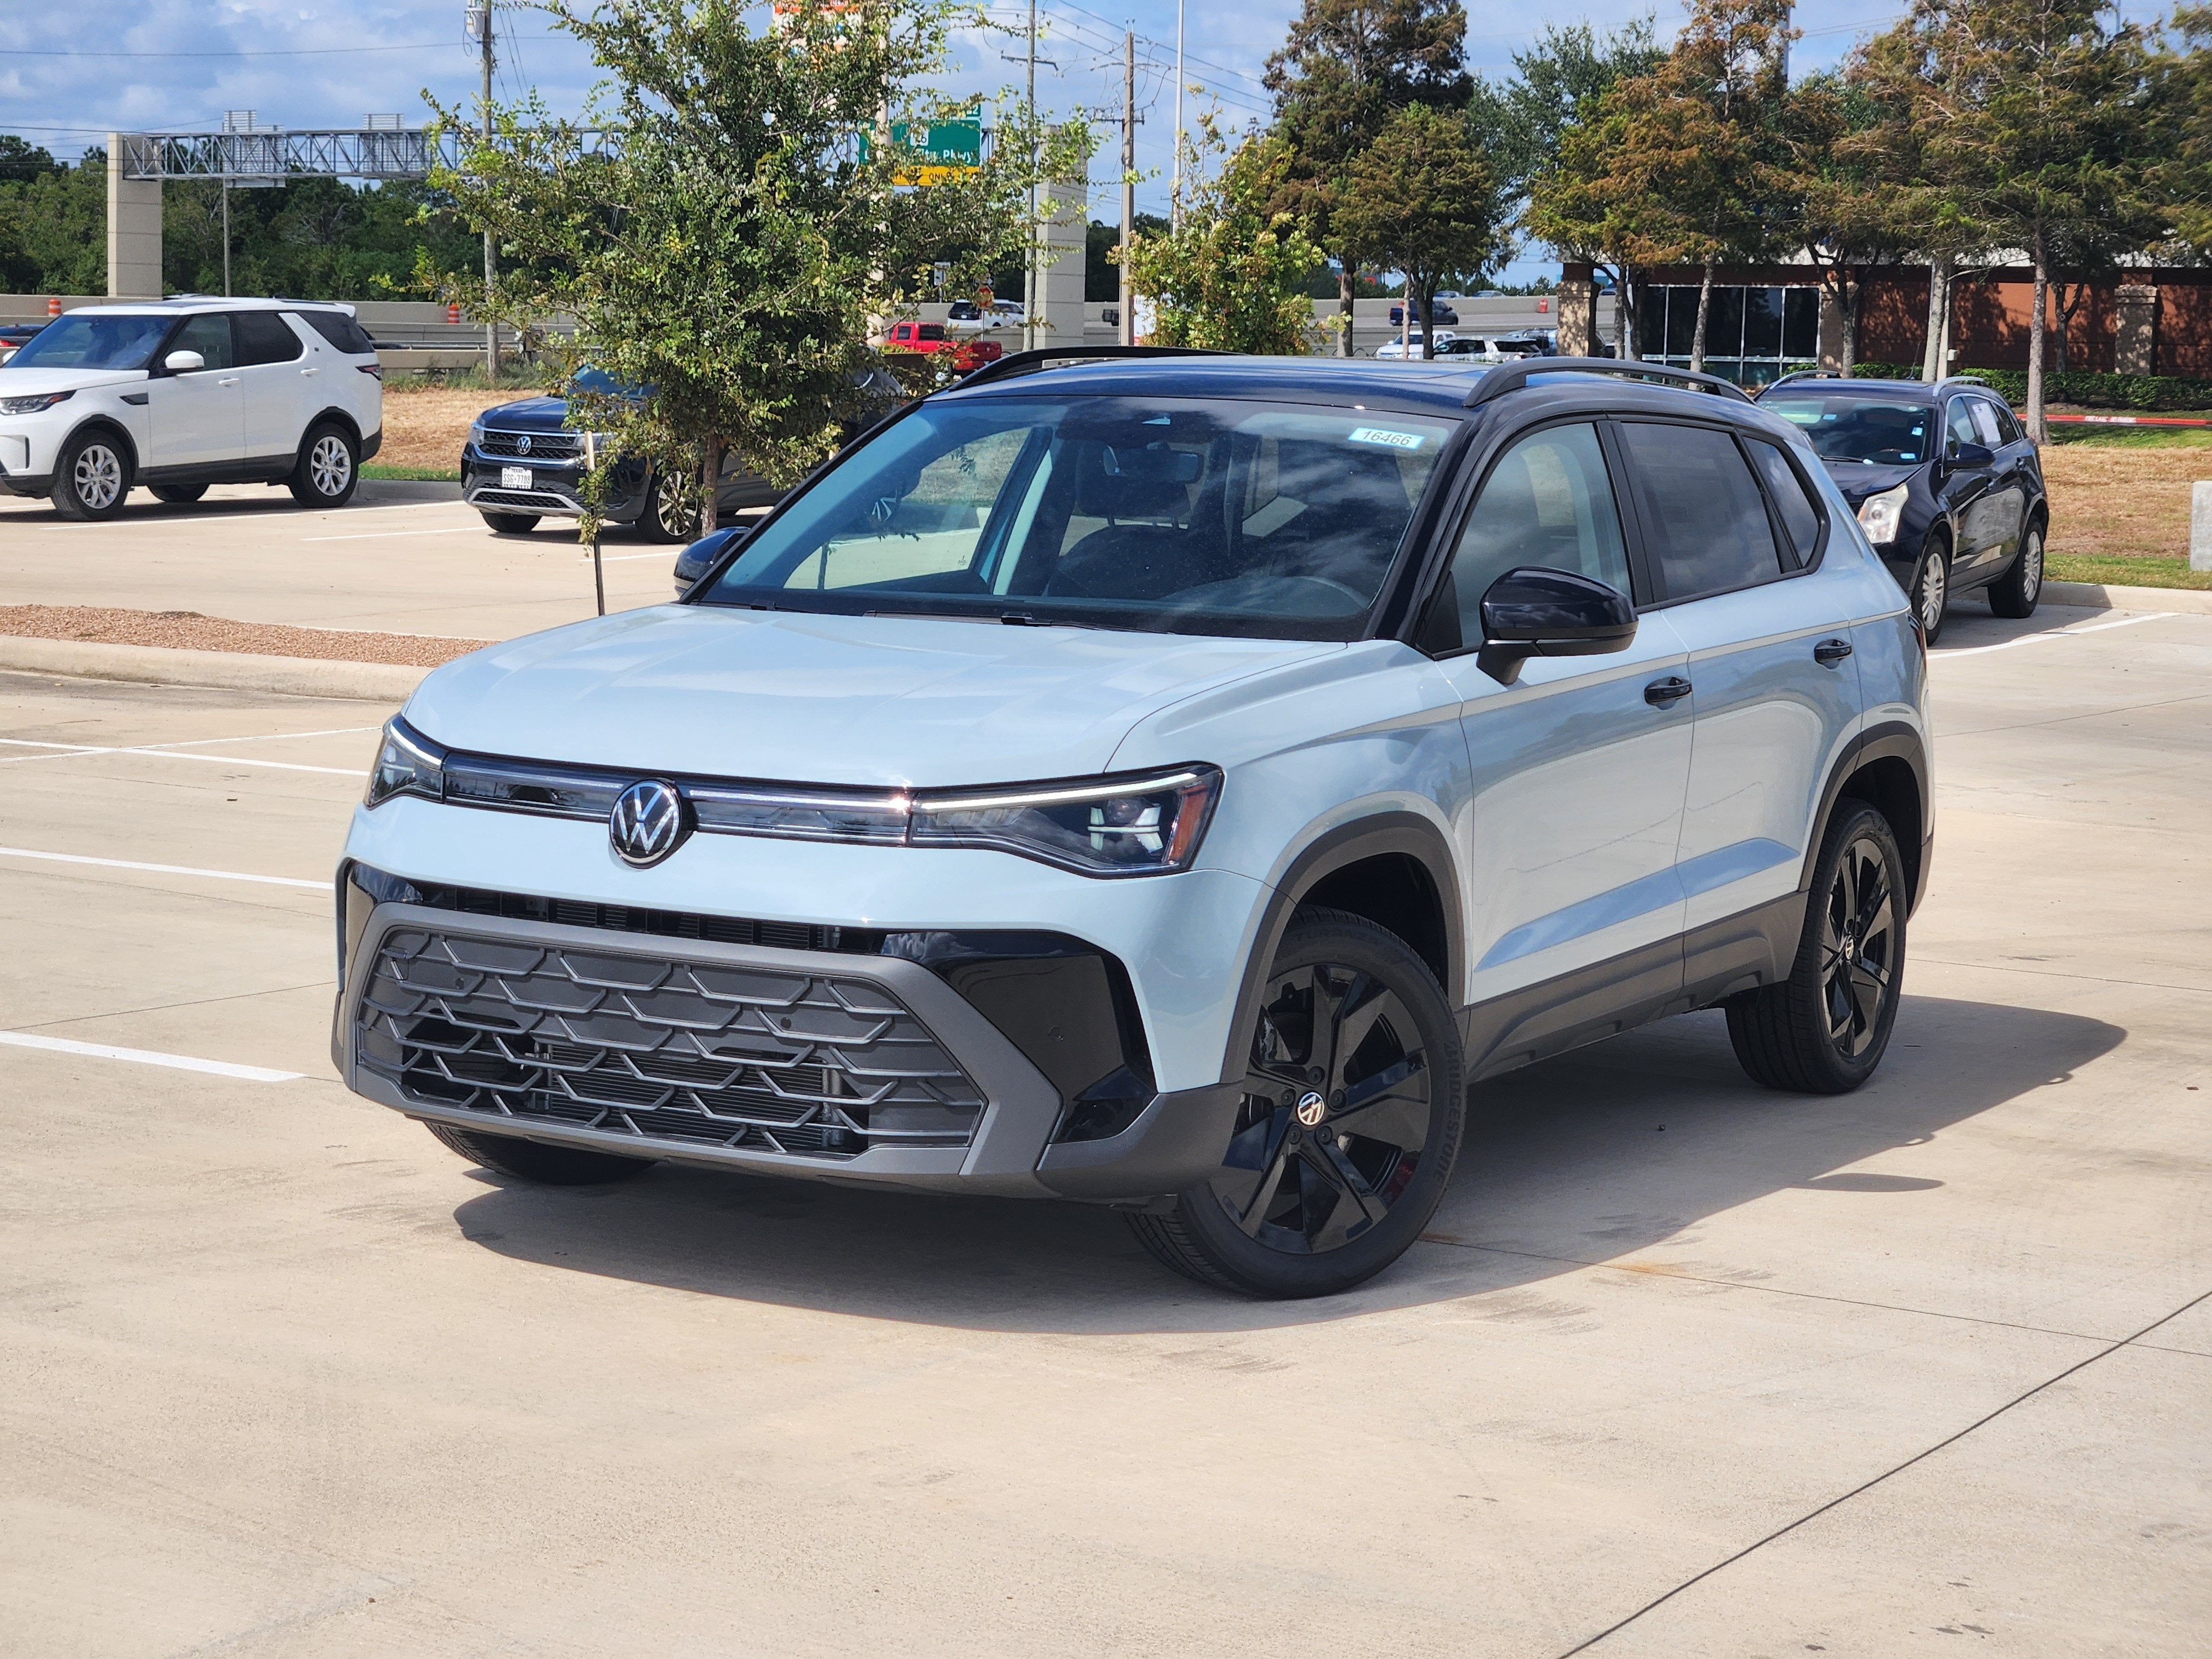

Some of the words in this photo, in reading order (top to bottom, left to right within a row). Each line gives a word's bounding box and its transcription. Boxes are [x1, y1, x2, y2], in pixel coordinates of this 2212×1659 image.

[1363, 430, 1412, 446] 16466
[614, 783, 678, 857] VW
[1432, 1040, 1461, 1184] BRIDGESTONE
